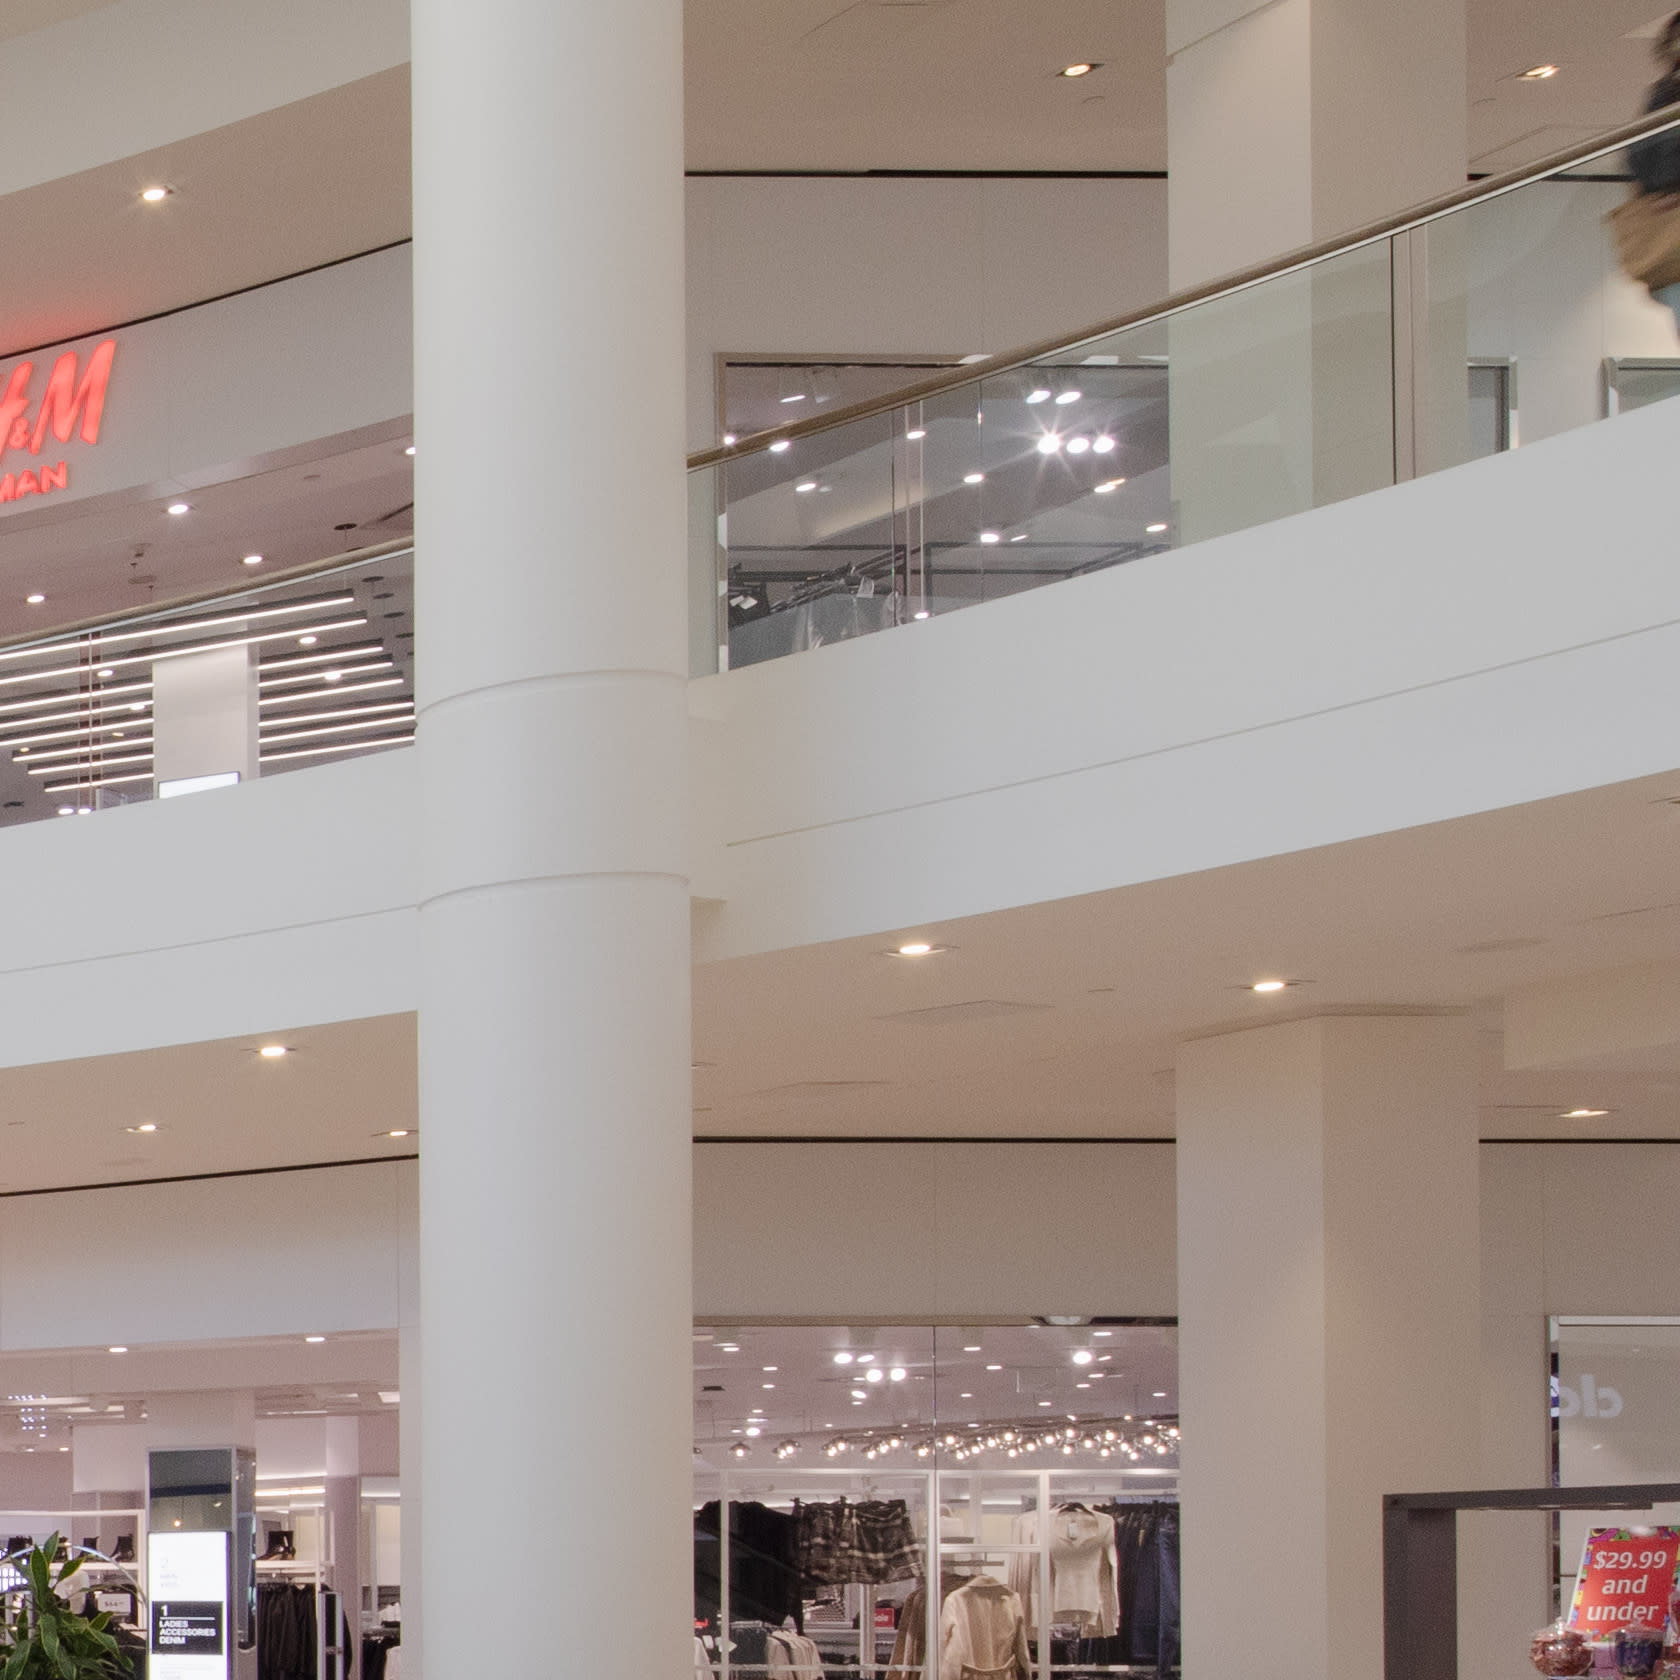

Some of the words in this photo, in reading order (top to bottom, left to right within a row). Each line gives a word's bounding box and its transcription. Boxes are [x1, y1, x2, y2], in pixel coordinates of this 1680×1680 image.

[1593, 1550, 1668, 1570] $29.99
[1601, 1574, 1649, 1595] and
[1586, 1601, 1660, 1622] under
